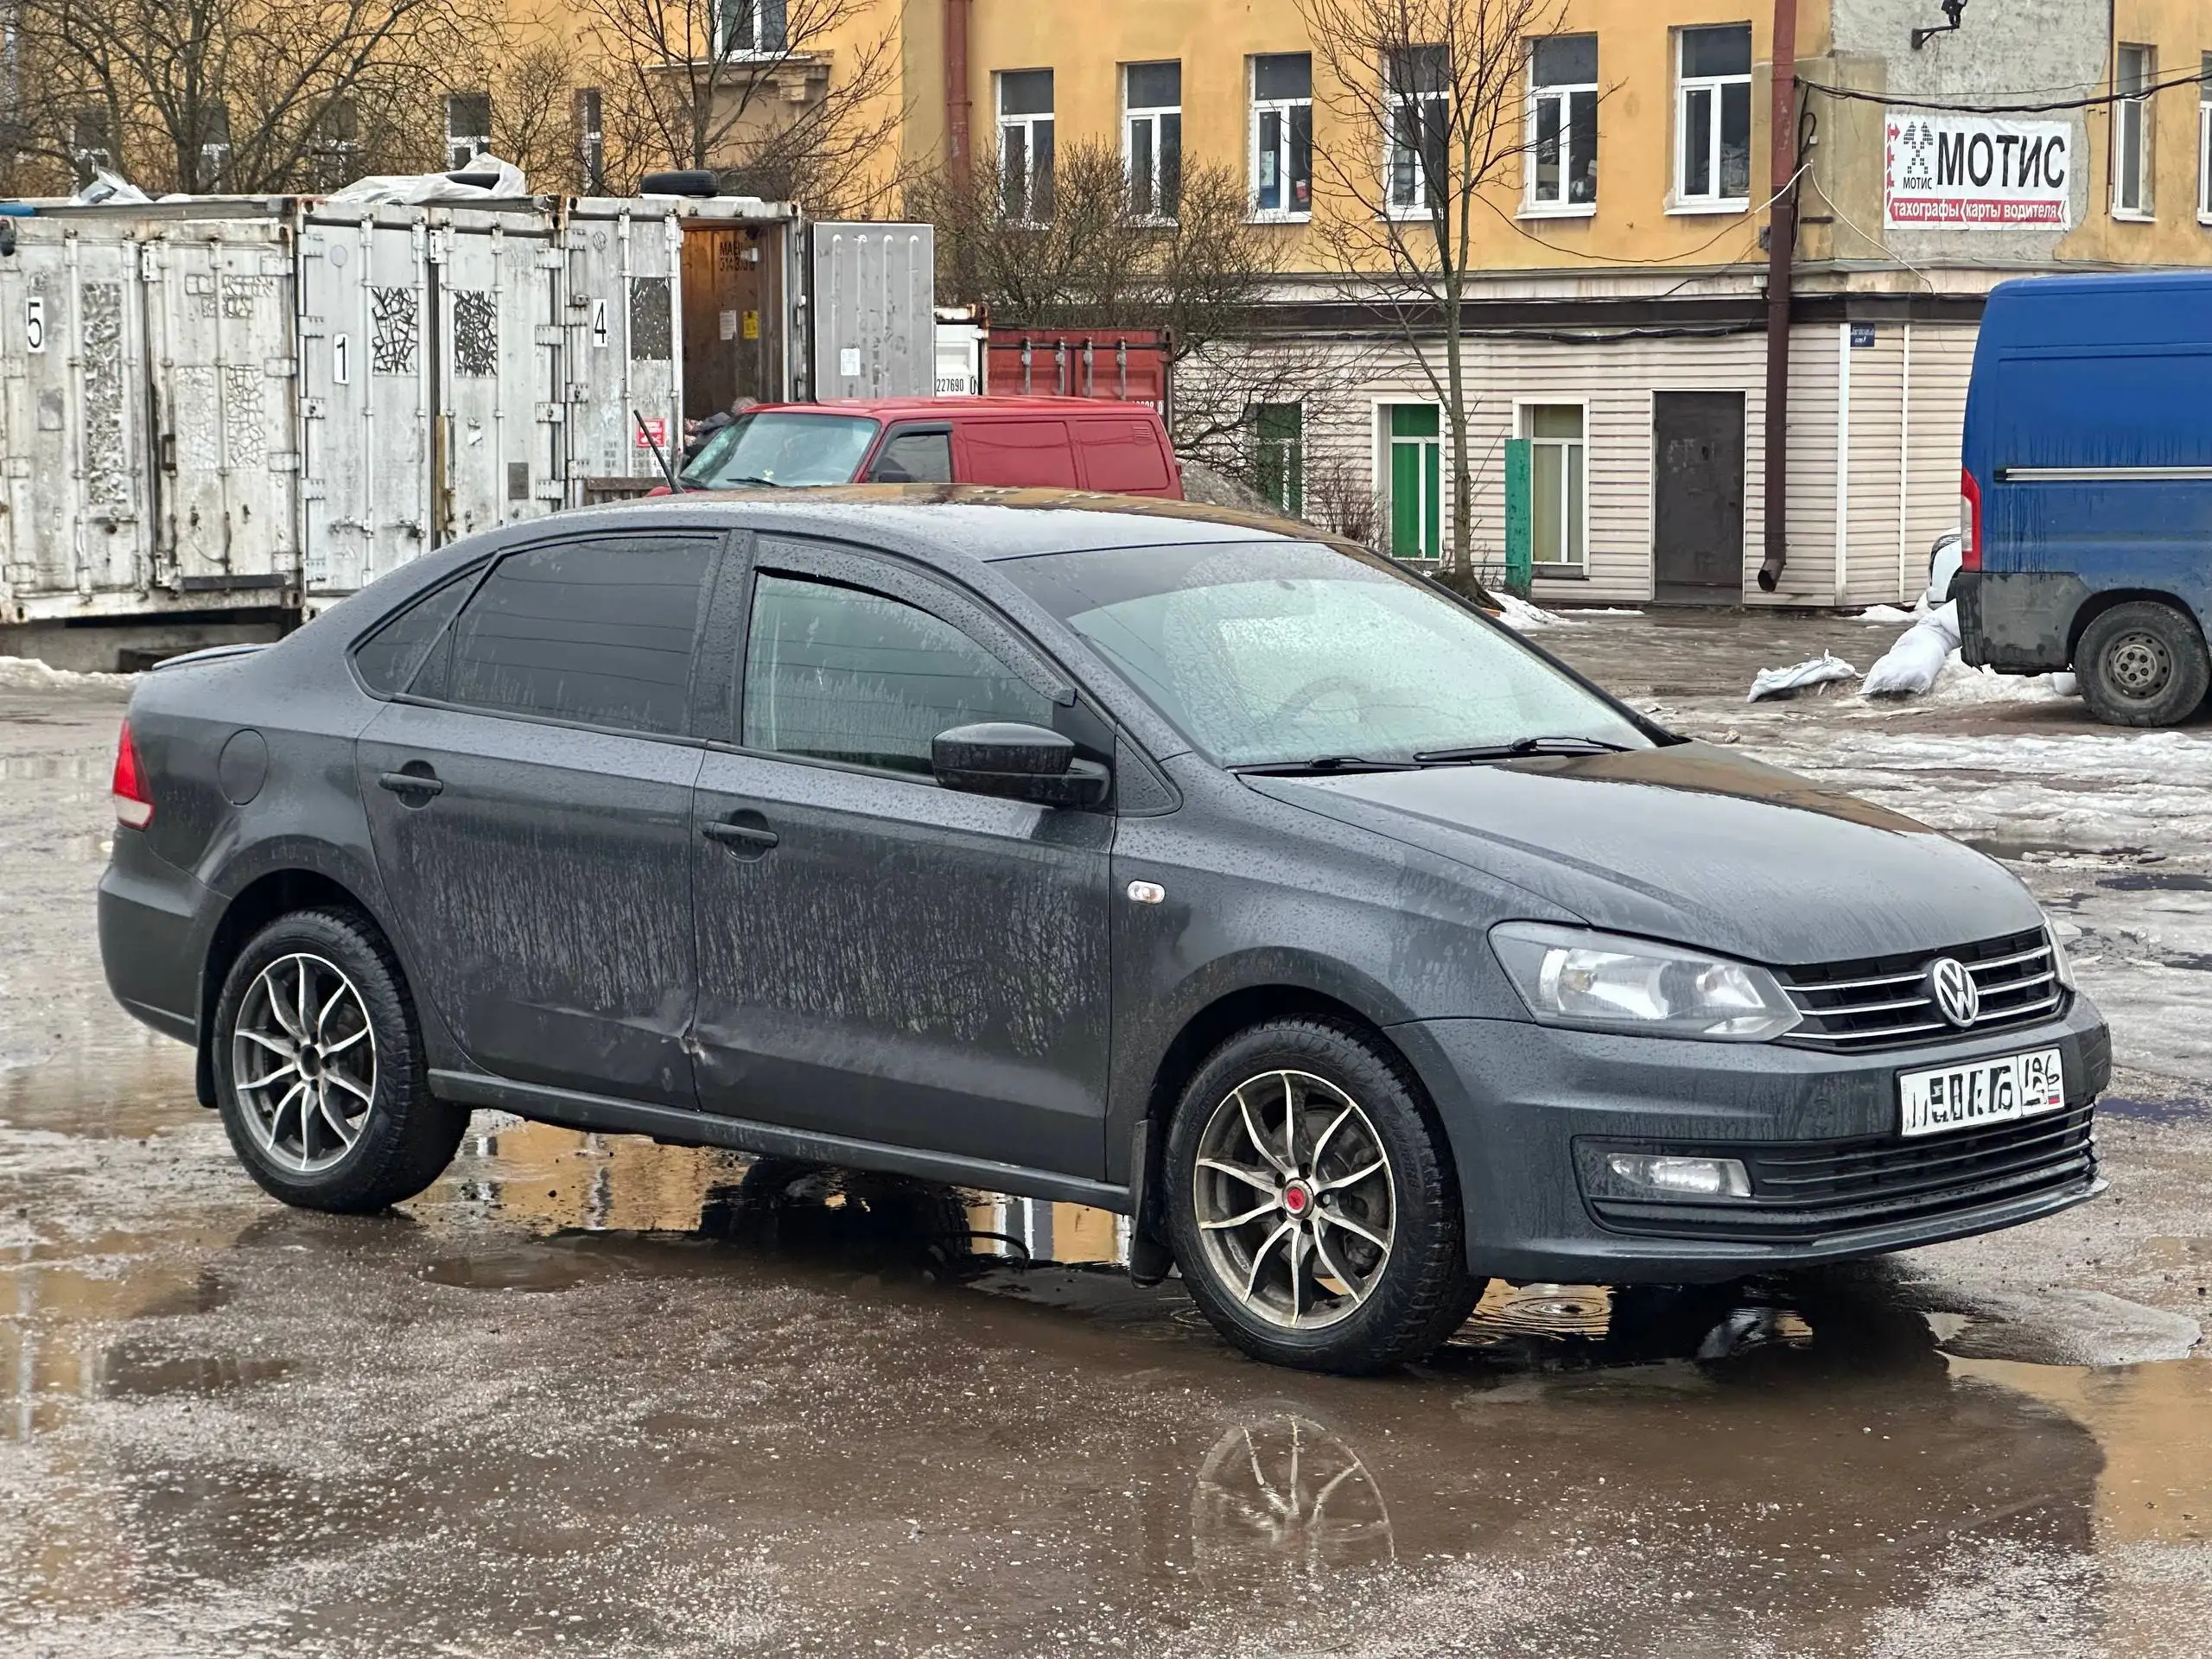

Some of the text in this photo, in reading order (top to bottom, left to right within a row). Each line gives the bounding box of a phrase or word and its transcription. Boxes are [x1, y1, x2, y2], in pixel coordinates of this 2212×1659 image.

[1937, 131, 2065, 188] МОТИС
[1903, 176, 1933, 190] МОТИС
[1893, 200, 2056, 221] тахографы карты водителя
[27, 302, 42, 348] 5
[594, 302, 607, 344] 4
[336, 336, 346, 381] 1
[936, 378, 964, 392] 227690
